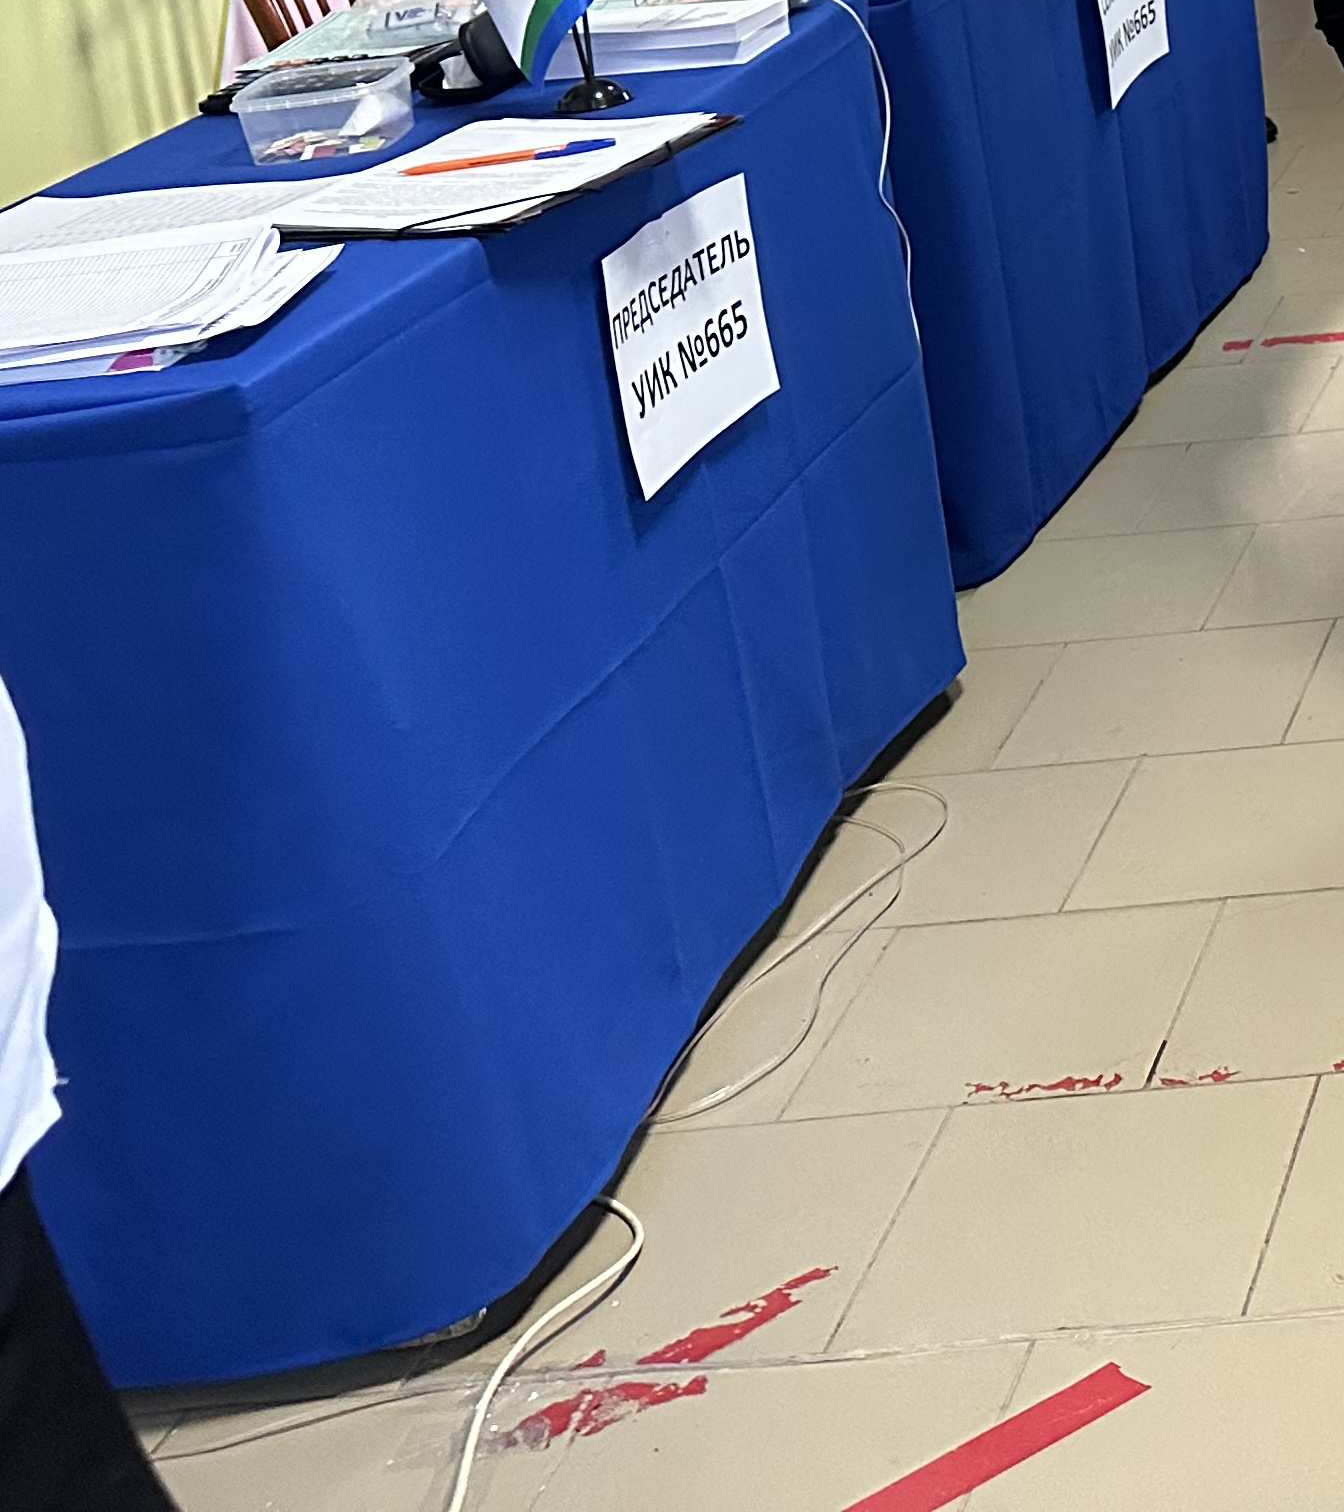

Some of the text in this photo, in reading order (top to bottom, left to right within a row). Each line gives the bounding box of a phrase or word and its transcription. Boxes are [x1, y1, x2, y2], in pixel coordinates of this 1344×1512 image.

[1122, 0, 1157, 48] №665
[611, 229, 751, 350] ПРЕДСЕДАТЕЛЬ
[631, 299, 749, 420] УИК №665
